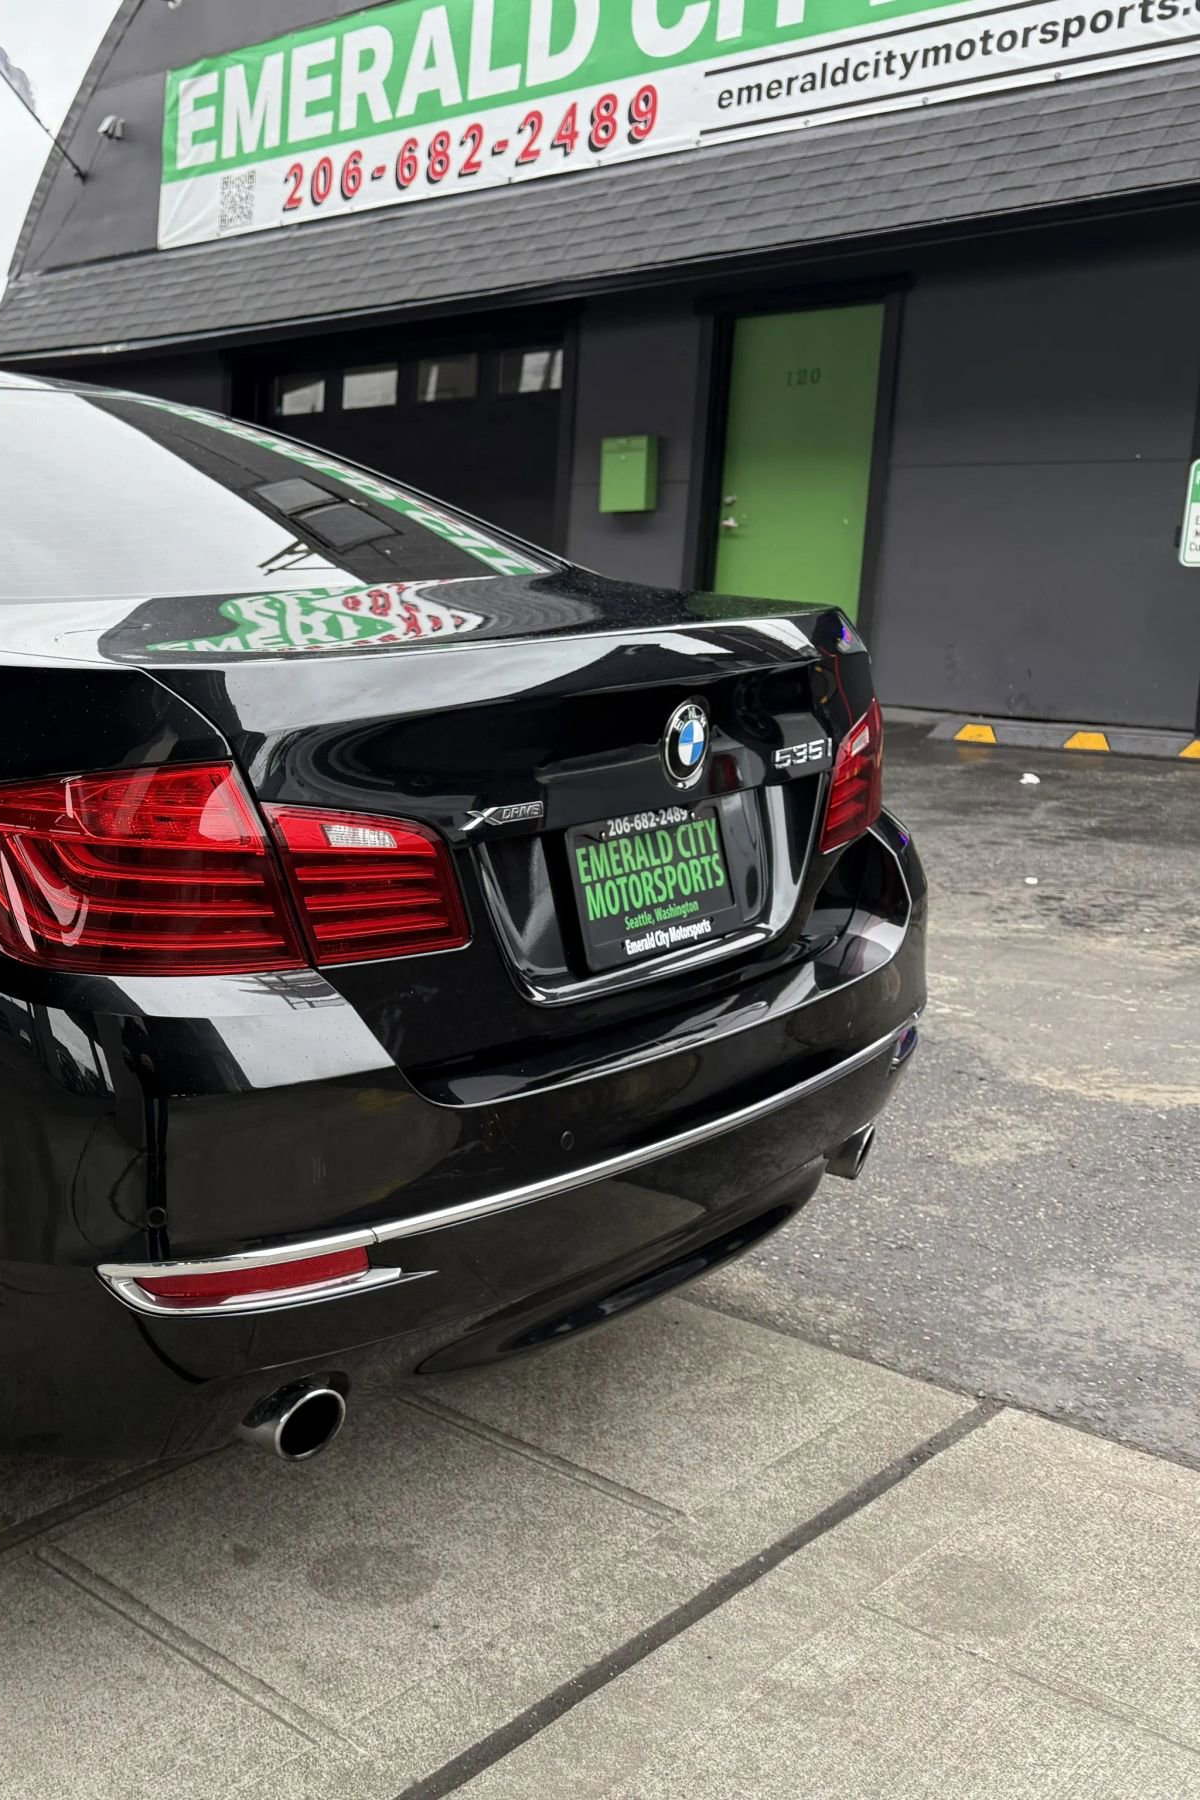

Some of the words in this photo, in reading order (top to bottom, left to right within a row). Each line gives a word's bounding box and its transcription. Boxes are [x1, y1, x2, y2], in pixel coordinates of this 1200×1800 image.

[176, 0, 600, 170] EMERALD
[717, 0, 1200, 110] emeraldcitymotorsports.
[283, 84, 658, 211] 206-682-2489
[576, 829, 673, 884] EMERALD
[676, 818, 717, 859] CITY
[607, 806, 688, 837] 206-682-2489
[584, 853, 725, 921] MOTORSPORTS
[625, 911, 656, 931] Seattle,
[655, 900, 699, 921] Washington
[625, 931, 656, 955] Emerald
[655, 929, 670, 948] City
[669, 918, 712, 943] Motorsports
